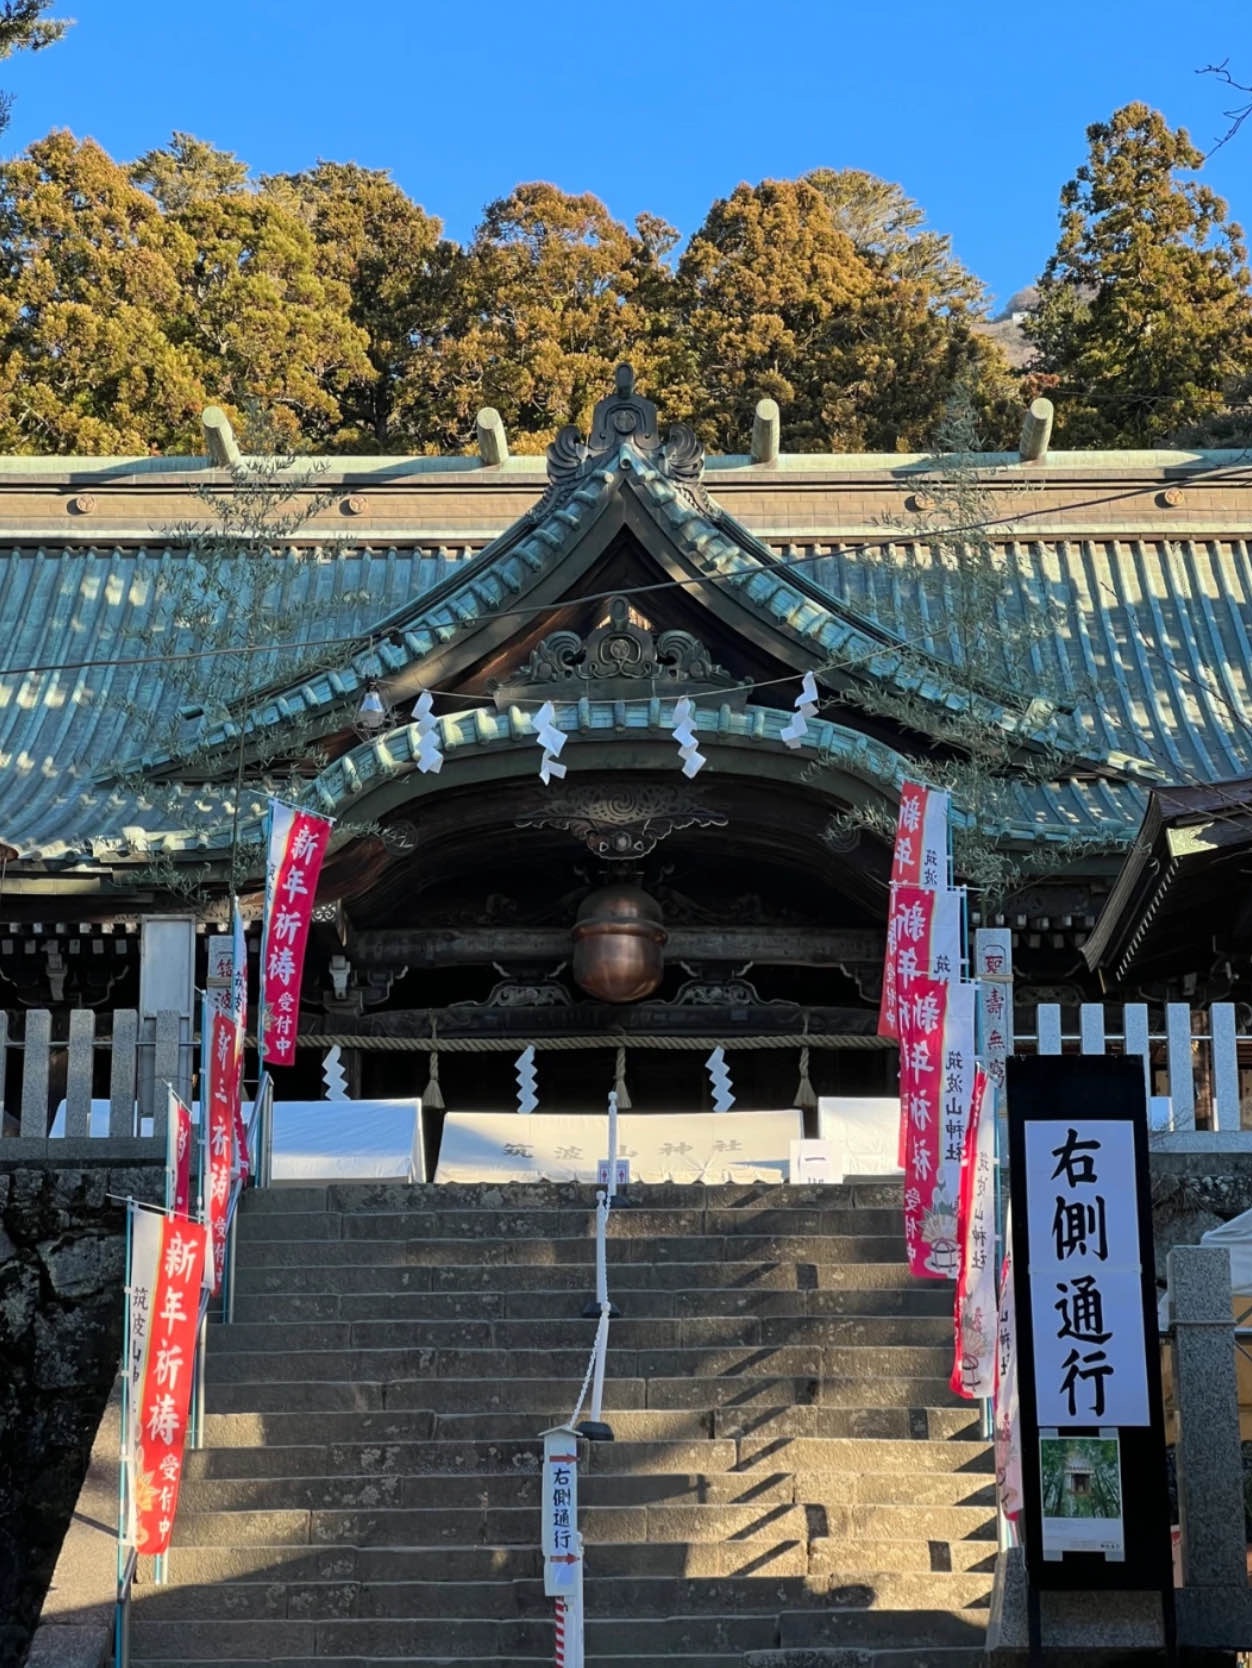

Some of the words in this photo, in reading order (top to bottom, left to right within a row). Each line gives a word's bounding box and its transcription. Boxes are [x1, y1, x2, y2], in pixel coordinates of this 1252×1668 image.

[267, 815, 319, 1057] 新年祈祷受付中
[146, 1231, 199, 1543] 新年祈祷受付中
[1051, 1128, 1114, 1416] 右側通行
[553, 1468, 572, 1549] 右側通行
